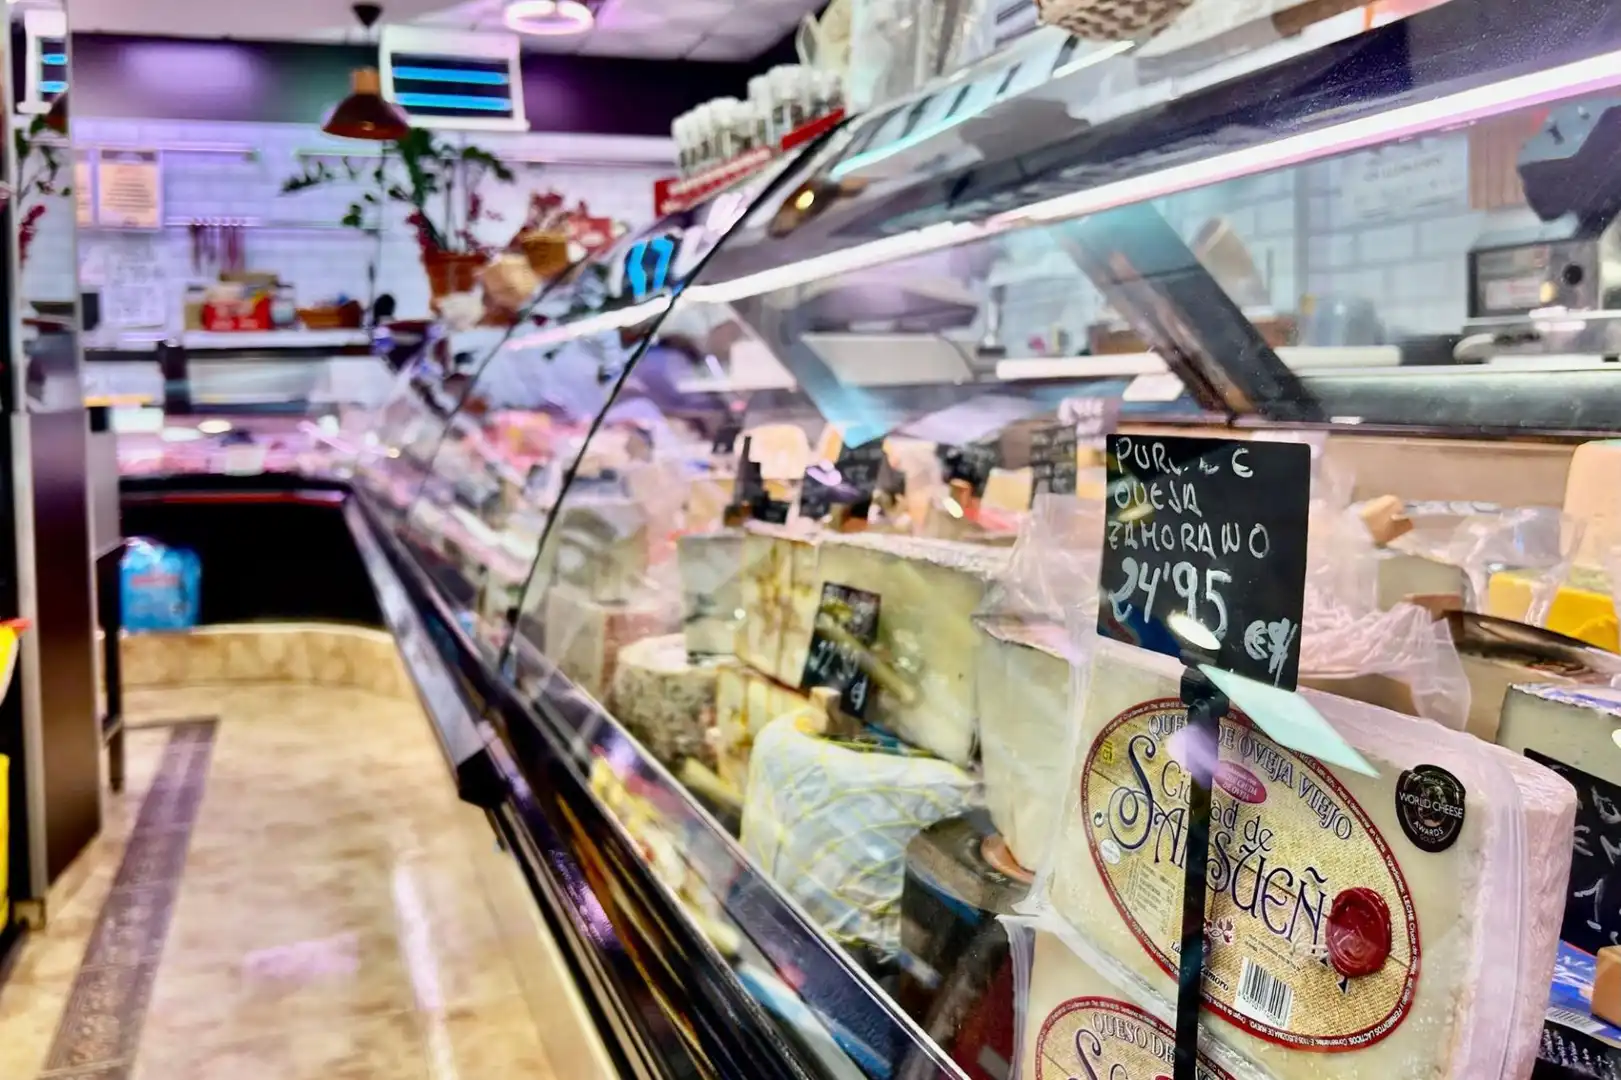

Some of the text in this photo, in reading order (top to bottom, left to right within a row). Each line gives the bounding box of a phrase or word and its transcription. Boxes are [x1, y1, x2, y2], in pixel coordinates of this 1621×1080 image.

[1108, 520, 1270, 560] ZAMORANO
[1238, 735, 1294, 789] OVEJA
[1299, 772, 1352, 840] VIEJO
[1399, 791, 1463, 819] WORLD CHEESE
[1243, 815, 1273, 852] de
[1413, 821, 1443, 837] AWARDS
[1403, 895, 1414, 921] LECHE
[1091, 1012, 1148, 1049] QUESO
